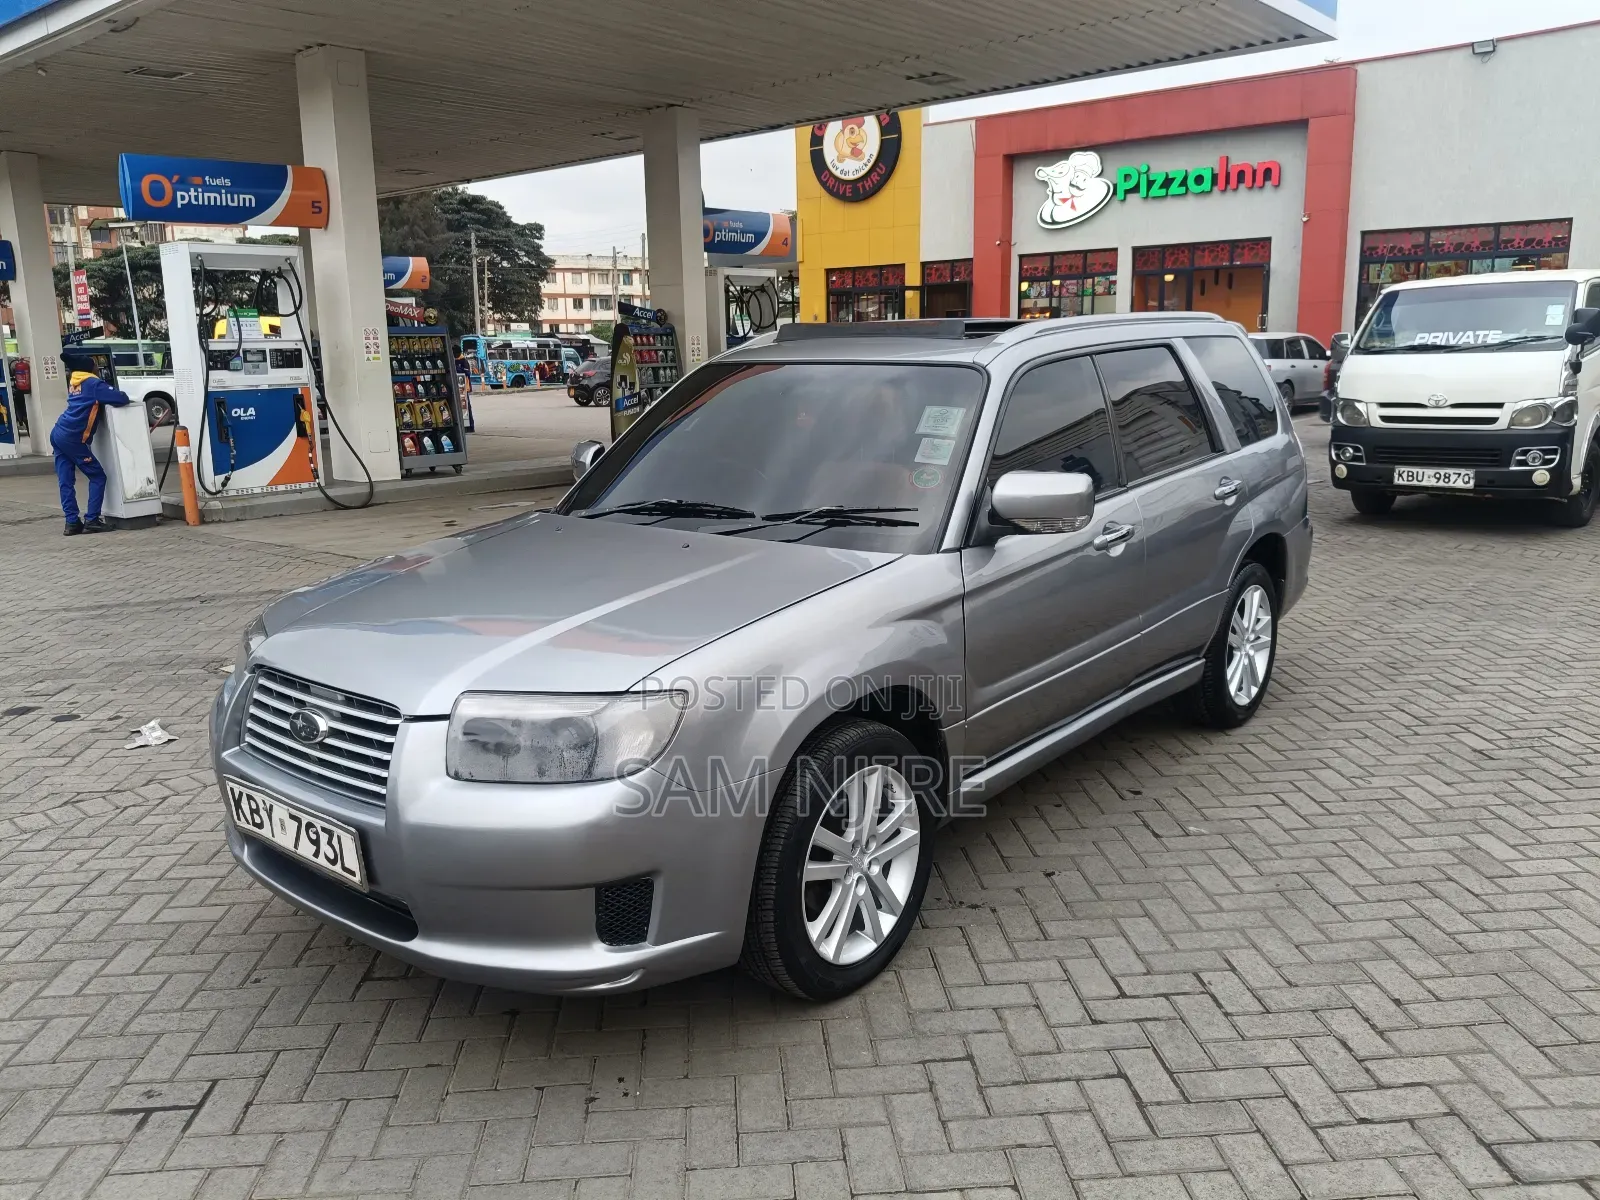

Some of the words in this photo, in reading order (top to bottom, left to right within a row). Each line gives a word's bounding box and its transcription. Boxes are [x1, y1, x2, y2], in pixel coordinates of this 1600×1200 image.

[205, 175, 231, 186] fuels
[821, 171, 852, 196] DRIVE
[856, 163, 886, 193] THRU
[311, 201, 323, 214] 5
[782, 238, 789, 247] 4
[421, 275, 428, 283] 2
[633, 307, 654, 319] Accel
[69, 331, 91, 342] Accel
[1413, 330, 1502, 345] PRIVATE
[622, 395, 639, 408] Accel
[231, 407, 256, 417] OLA
[1397, 470, 1425, 482] KBU
[229, 787, 275, 838] KBY
[288, 813, 357, 877] 793L
